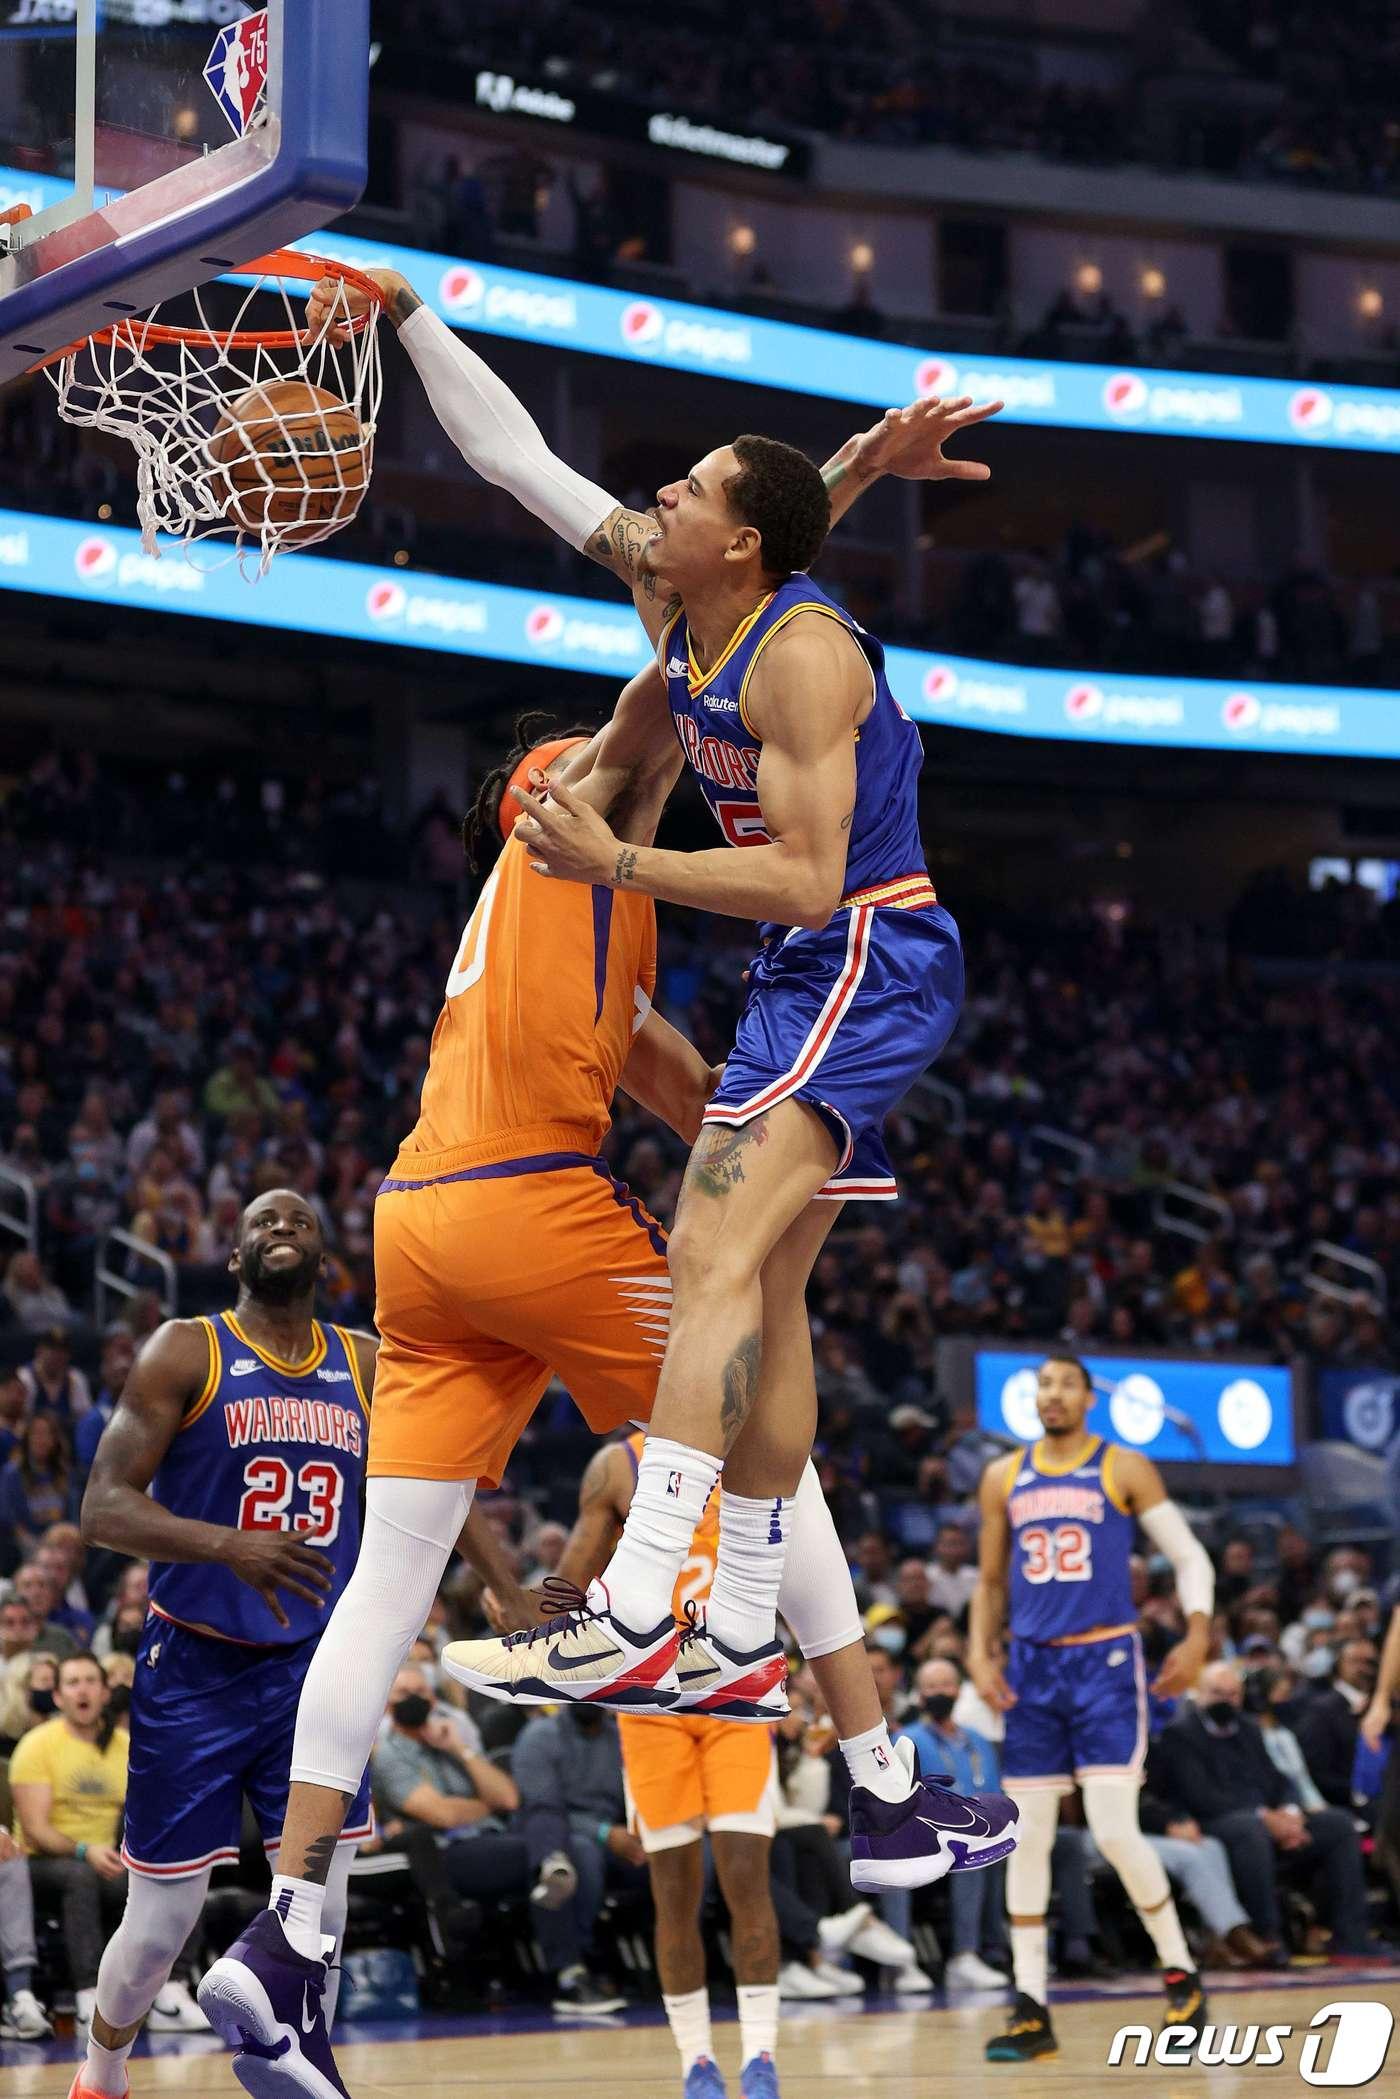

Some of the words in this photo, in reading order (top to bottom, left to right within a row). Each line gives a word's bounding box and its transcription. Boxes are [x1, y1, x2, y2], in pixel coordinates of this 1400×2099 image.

[249, 28, 265, 67] 75
[223, 1396, 361, 1459] WARRIORS
[237, 1456, 344, 1547] 23
[1019, 1523, 1093, 1584] 32
